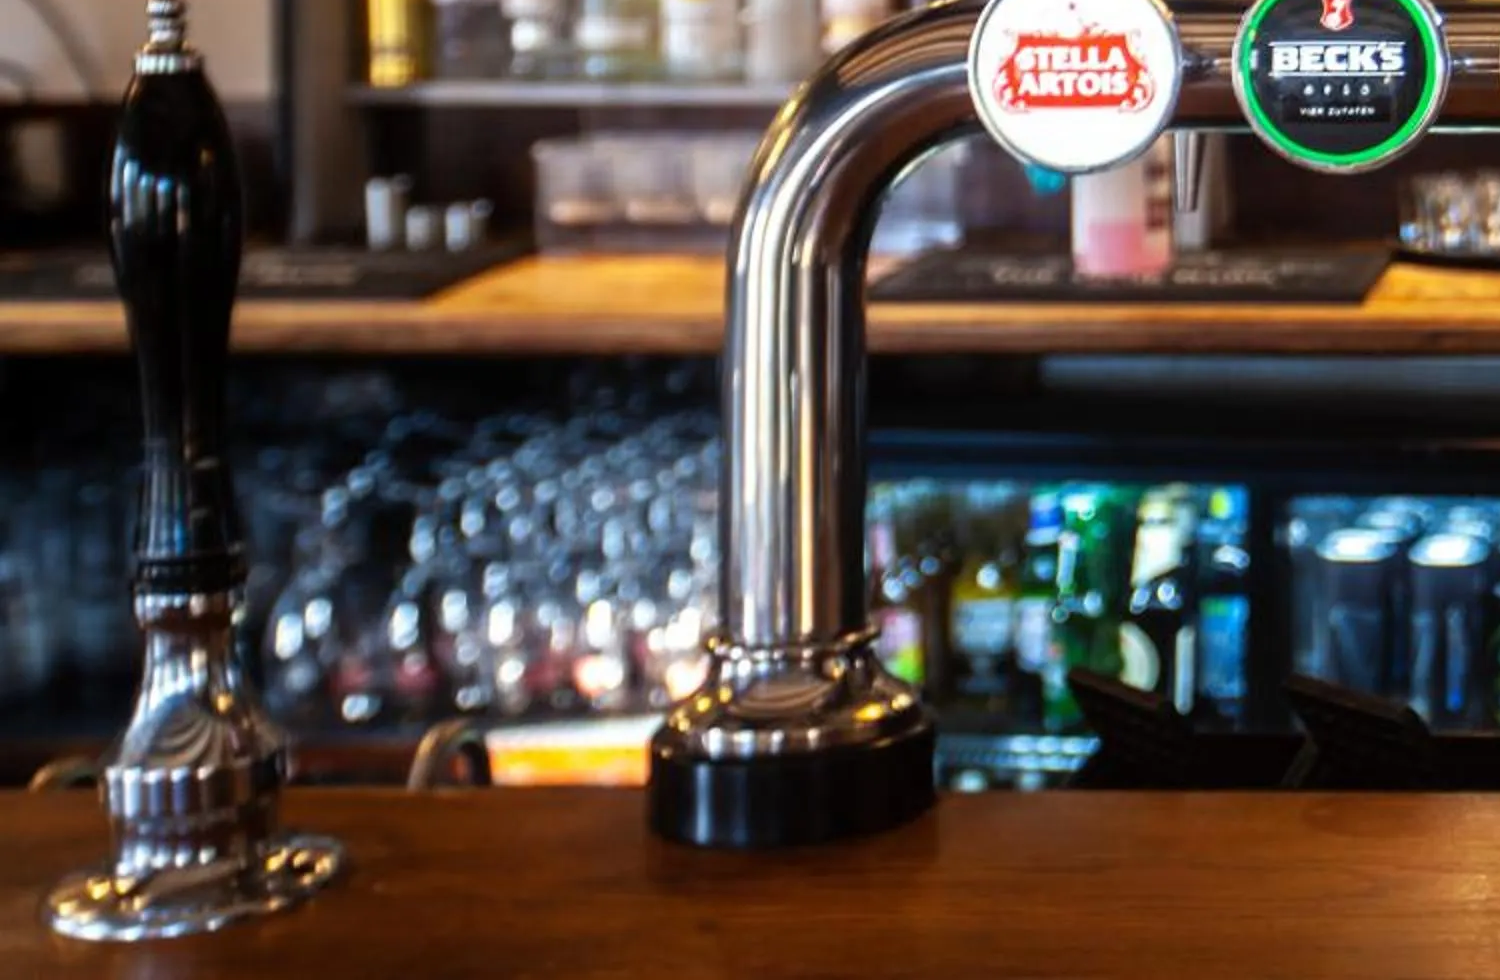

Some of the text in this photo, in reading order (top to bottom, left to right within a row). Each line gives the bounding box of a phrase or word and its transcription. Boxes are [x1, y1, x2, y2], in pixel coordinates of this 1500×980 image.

[1016, 46, 1127, 72] STELLA
[1272, 43, 1404, 71] BECK'S
[1018, 72, 1130, 98] ARTOIS
